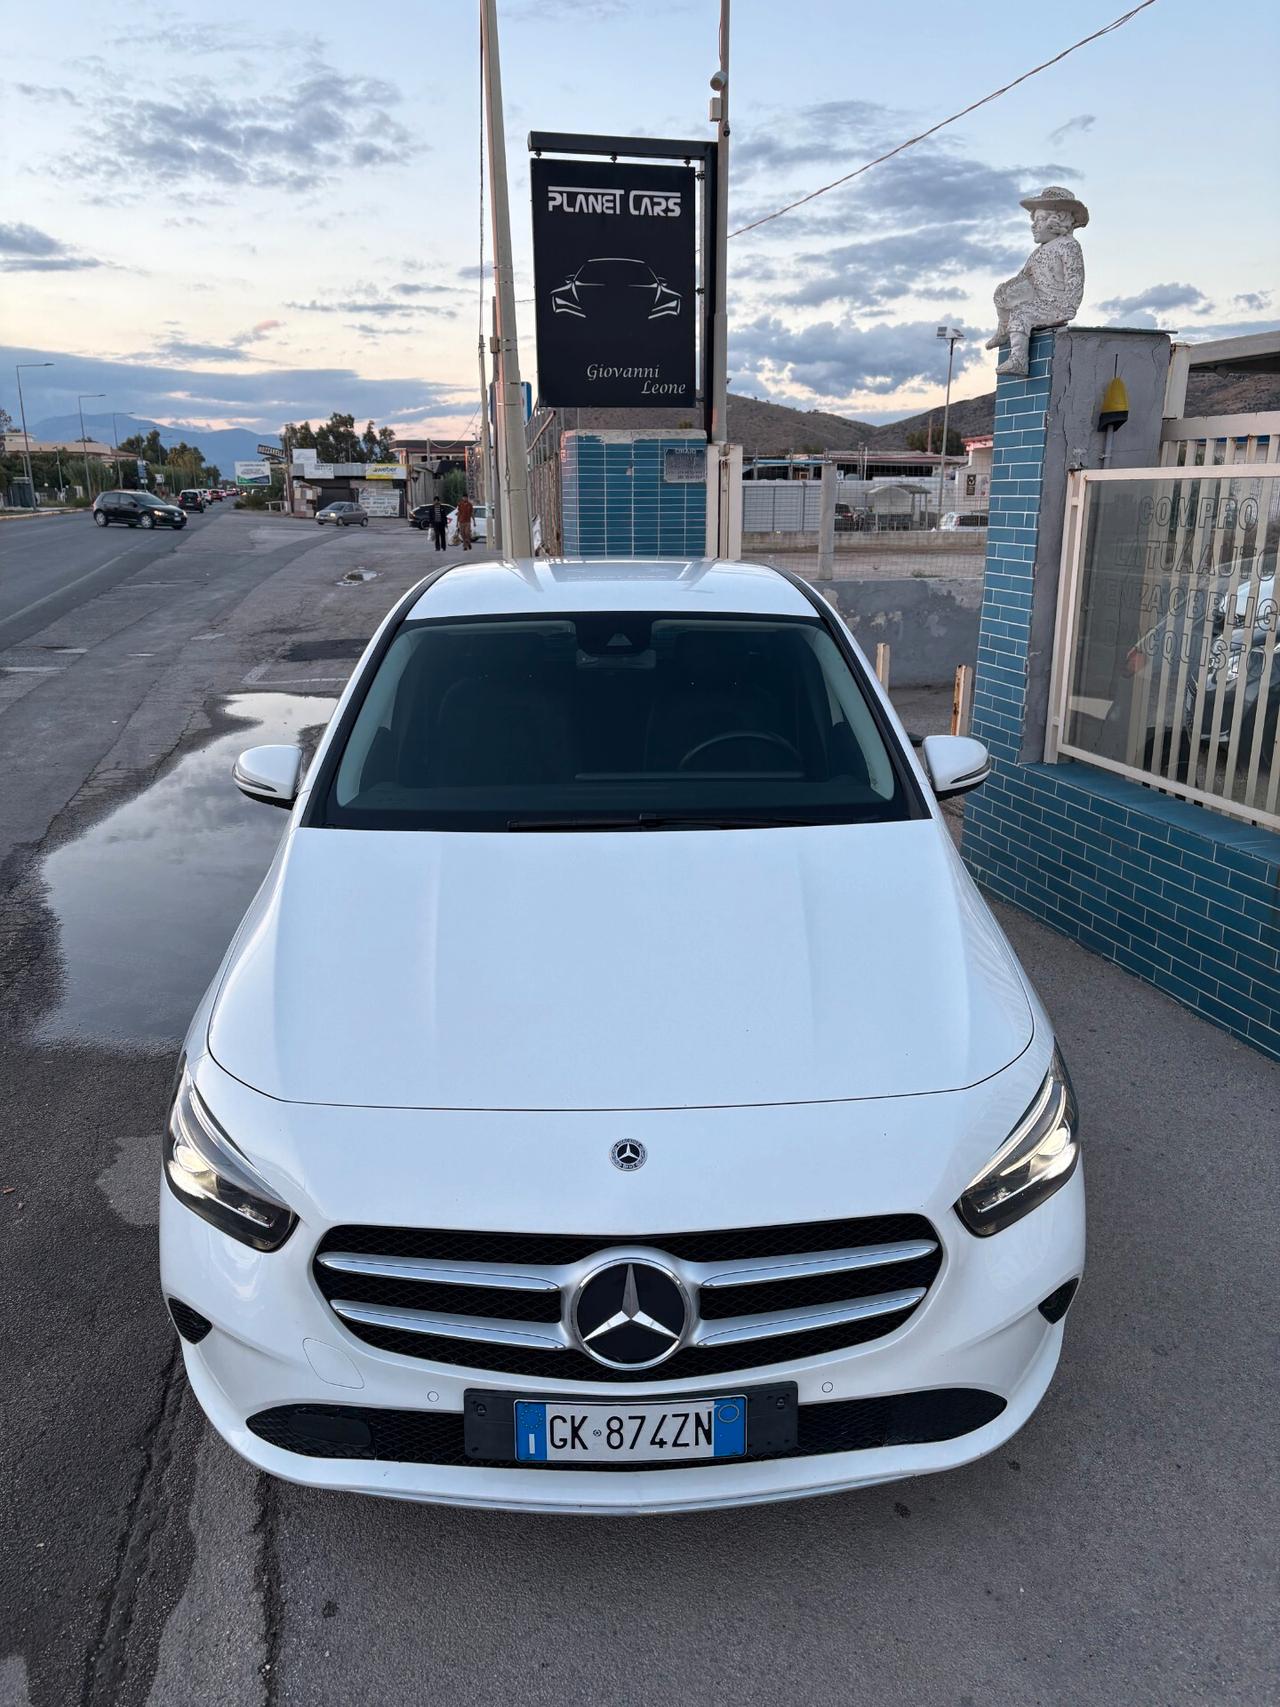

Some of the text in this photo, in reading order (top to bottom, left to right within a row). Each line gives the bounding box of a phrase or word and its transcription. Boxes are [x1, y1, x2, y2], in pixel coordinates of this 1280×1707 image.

[547, 185, 681, 217] PLANET CARS
[587, 363, 660, 381] Giovanni
[641, 380, 686, 395] Leone
[1139, 496, 1259, 531] COMPRO
[1144, 537, 1194, 573] TUA
[1196, 543, 1278, 582] AUTO
[549, 1411, 712, 1450] GK 874ZN
